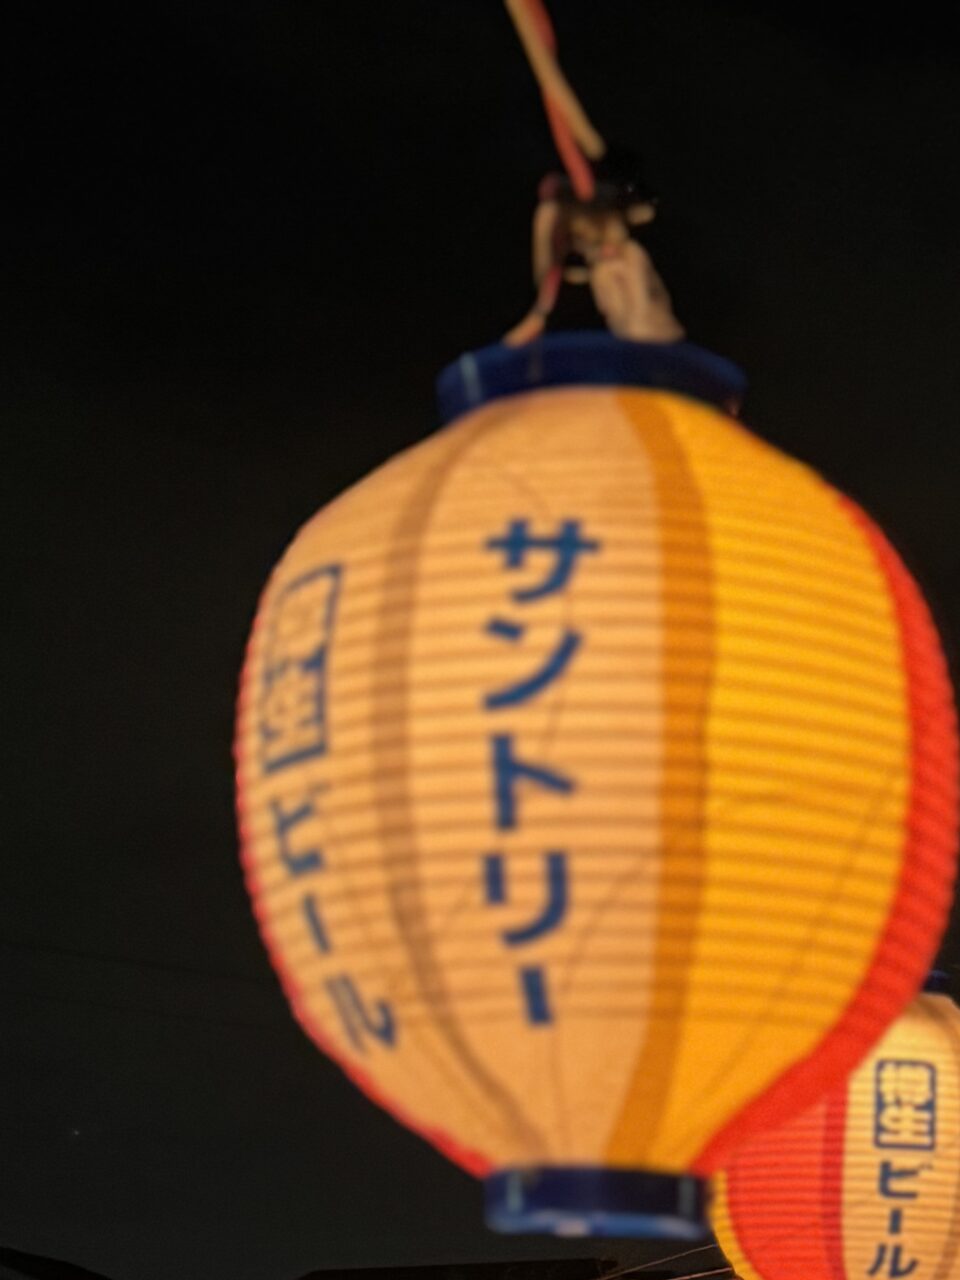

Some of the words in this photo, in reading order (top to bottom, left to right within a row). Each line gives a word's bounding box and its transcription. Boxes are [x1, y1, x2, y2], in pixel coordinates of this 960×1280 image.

[482, 519, 602, 1026] サントリー
